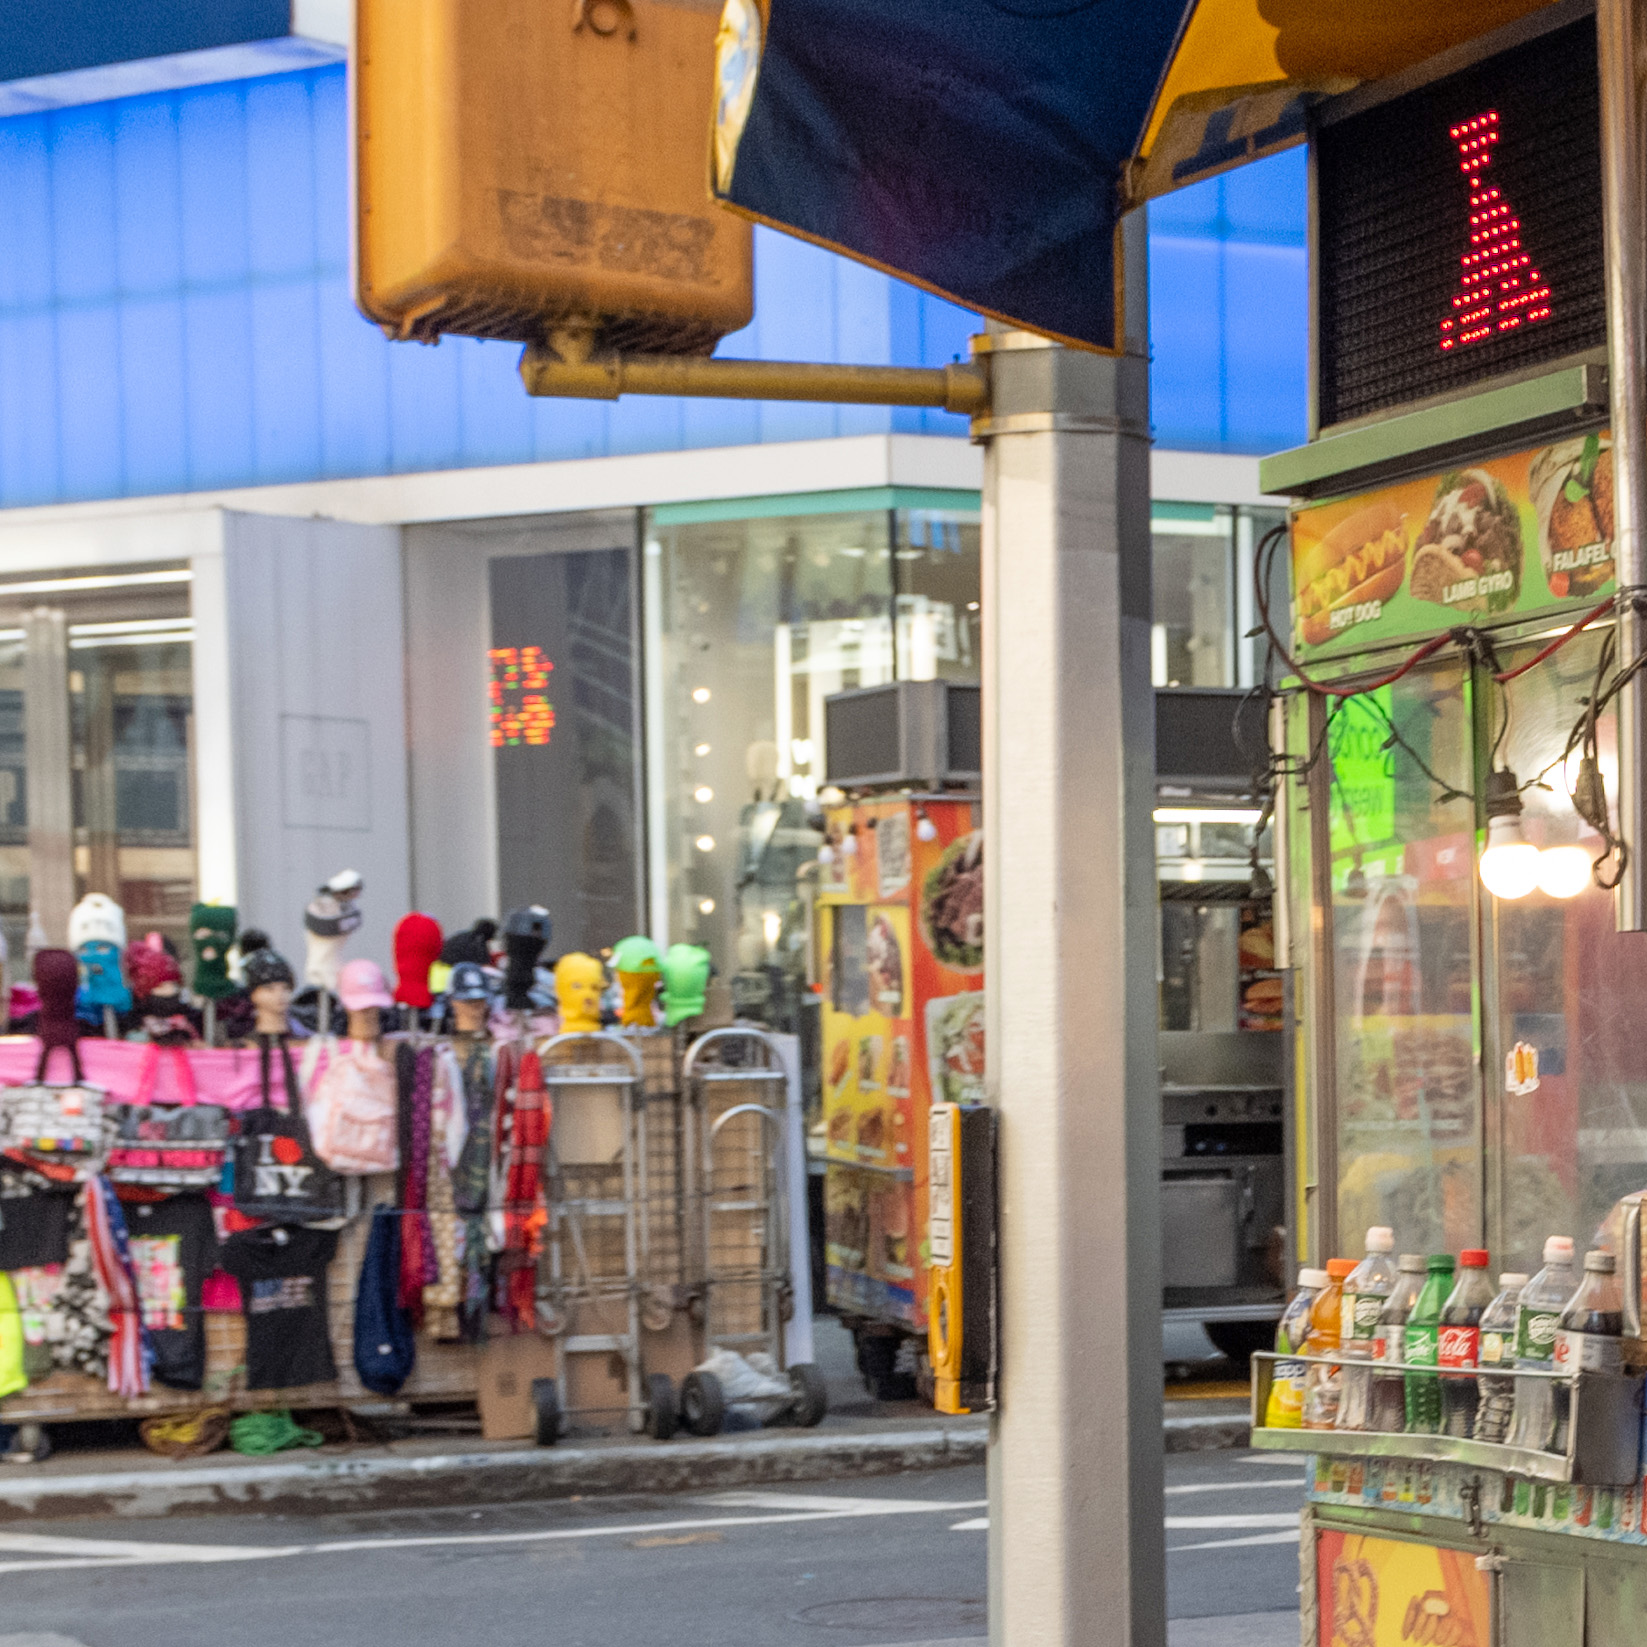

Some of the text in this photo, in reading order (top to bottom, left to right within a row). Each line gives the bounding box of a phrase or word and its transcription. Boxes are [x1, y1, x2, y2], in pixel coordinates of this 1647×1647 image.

[1553, 543, 1608, 573] FALAFEL
[1442, 570, 1515, 604] LAMB GYRO
[1329, 600, 1383, 630] HOT DOG
